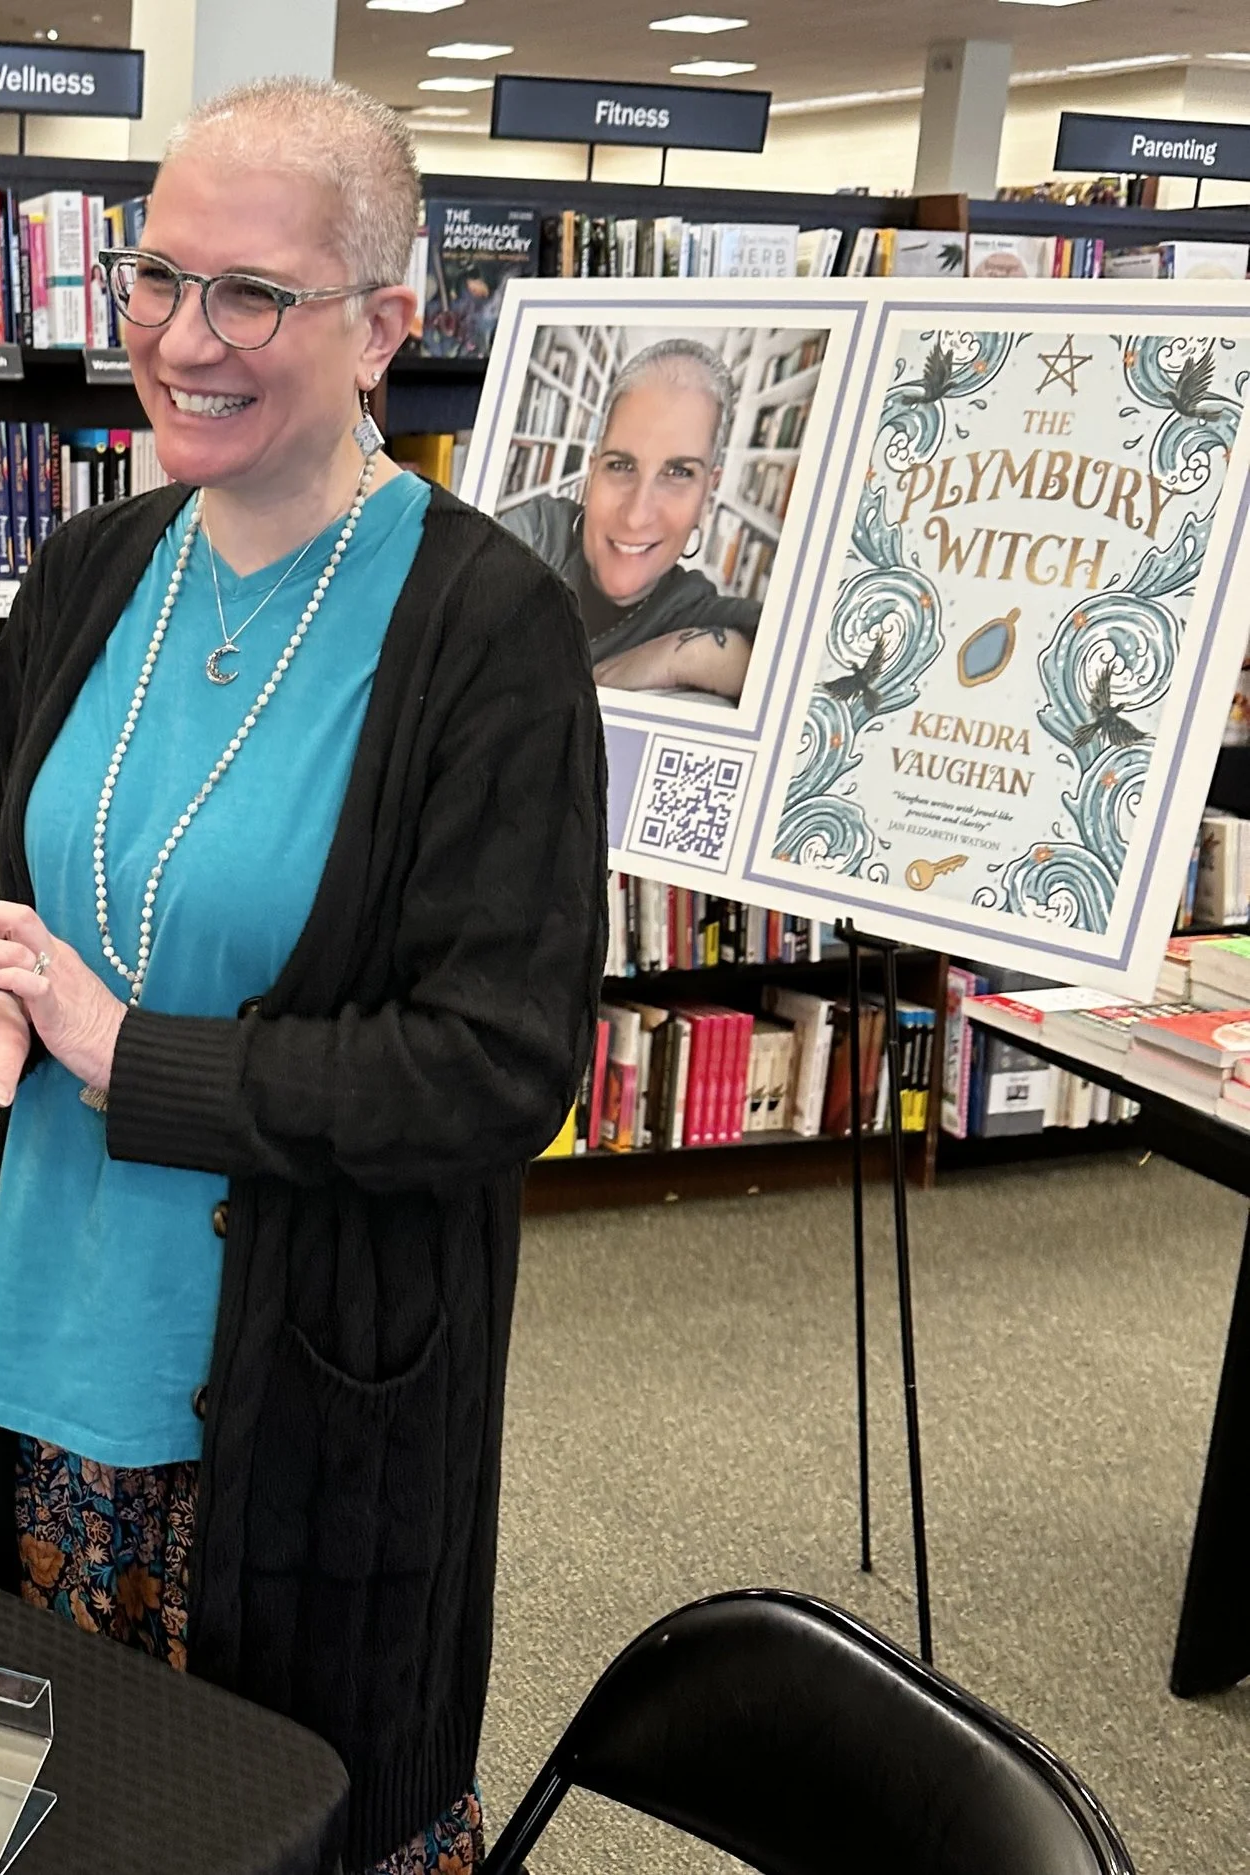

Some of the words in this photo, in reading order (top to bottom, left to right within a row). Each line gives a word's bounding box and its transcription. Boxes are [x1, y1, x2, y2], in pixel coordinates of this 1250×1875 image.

[595, 100, 670, 130] Fitness
[1131, 135, 1217, 167] Parenting
[443, 223, 520, 238] HANDMADE
[445, 209, 471, 224] THE
[442, 237, 533, 252] APOTHECARY
[730, 247, 787, 265] HERB
[1022, 409, 1076, 437] THE
[896, 447, 1183, 541] PLYMBURY
[923, 515, 1110, 590] WITCH
[908, 710, 1031, 756] KENDRA
[890, 746, 1036, 798] VAUGHAN
[905, 808, 941, 821] precision
[942, 815, 959, 824] and
[930, 799, 954, 811] writes
[955, 804, 974, 814] with
[973, 807, 1014, 822] jewel-like
[887, 820, 906, 831] JAN
[906, 823, 959, 843] ELIZABETH
[960, 834, 1001, 851] WATSON
